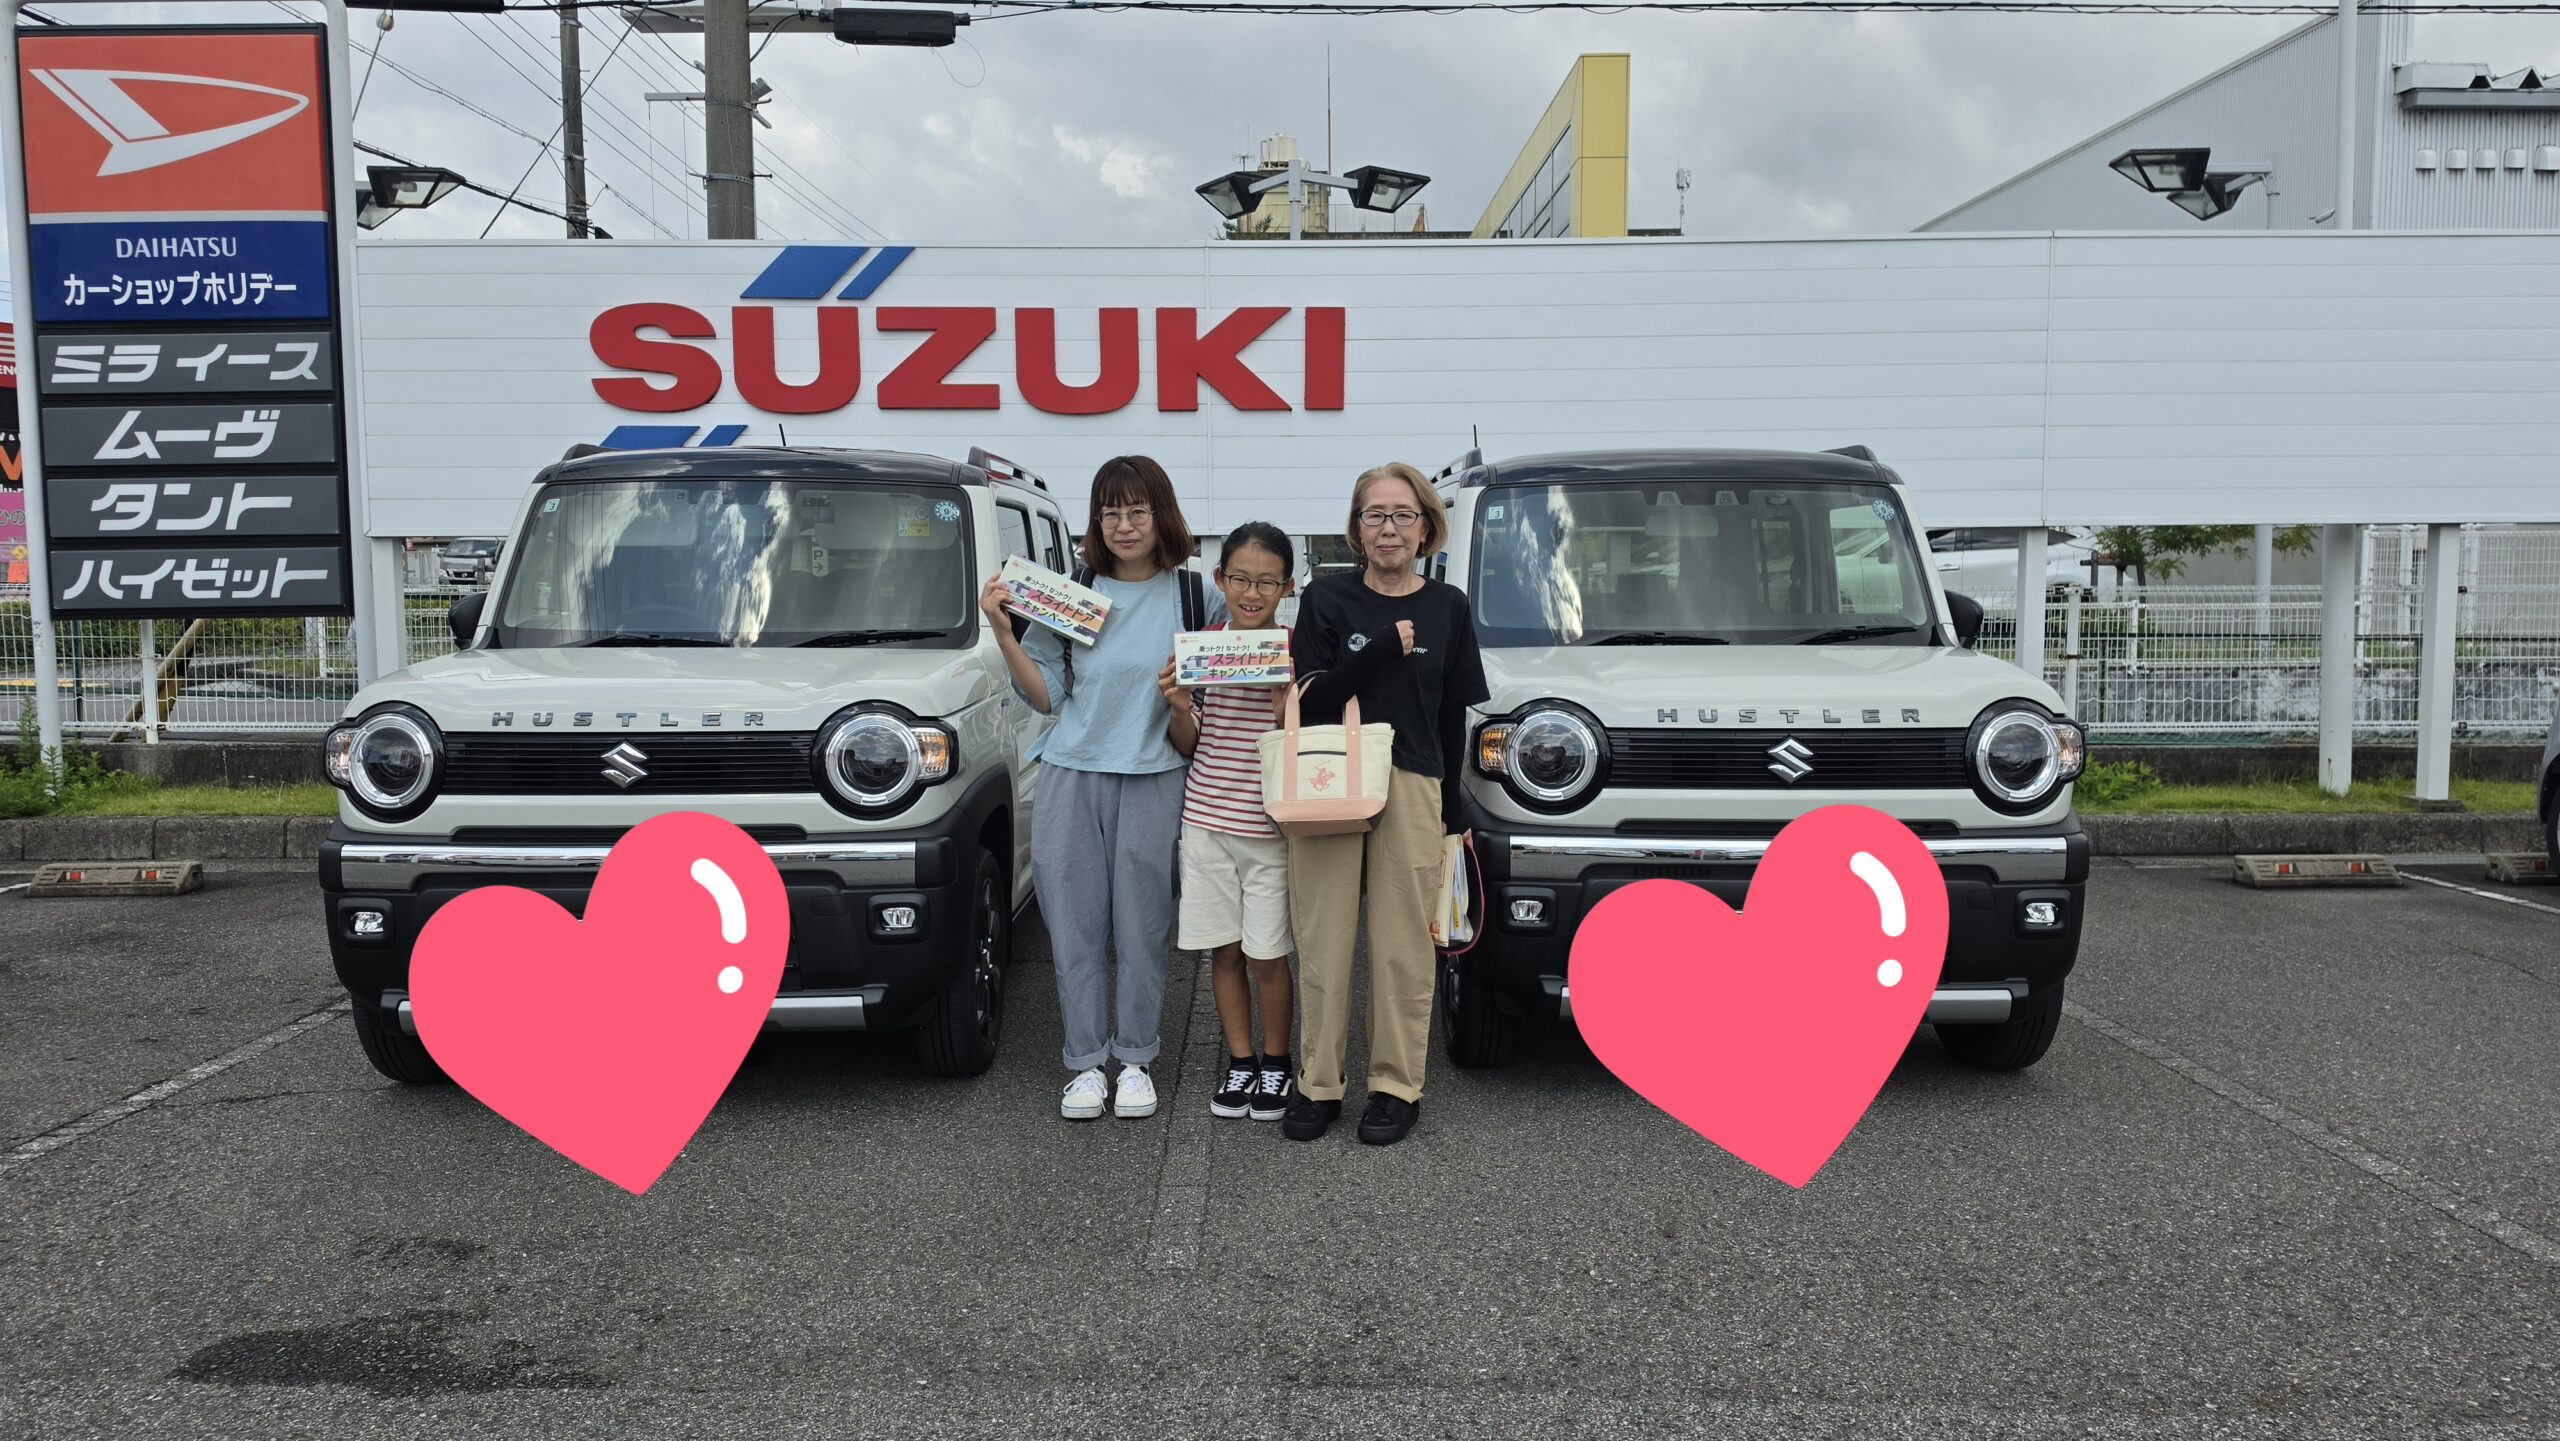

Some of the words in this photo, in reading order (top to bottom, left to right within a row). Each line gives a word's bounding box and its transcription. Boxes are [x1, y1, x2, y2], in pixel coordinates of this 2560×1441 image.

[116, 237, 237, 258] DAIHATSU
[64, 271, 297, 306] カーショップホリデー
[589, 302, 1346, 414] SUZUKI
[93, 410, 281, 459] ムーヴ
[91, 483, 292, 531] タント
[63, 558, 328, 600] ハイゼット
[1022, 600, 1074, 628] キャンペーン
[1031, 589, 1095, 622] スライドドア
[1209, 667, 1264, 679] キャンペーン
[1213, 651, 1281, 665] スライドドア
[491, 711, 764, 727] HUSTLER
[1657, 708, 1921, 724] HUSTLER
